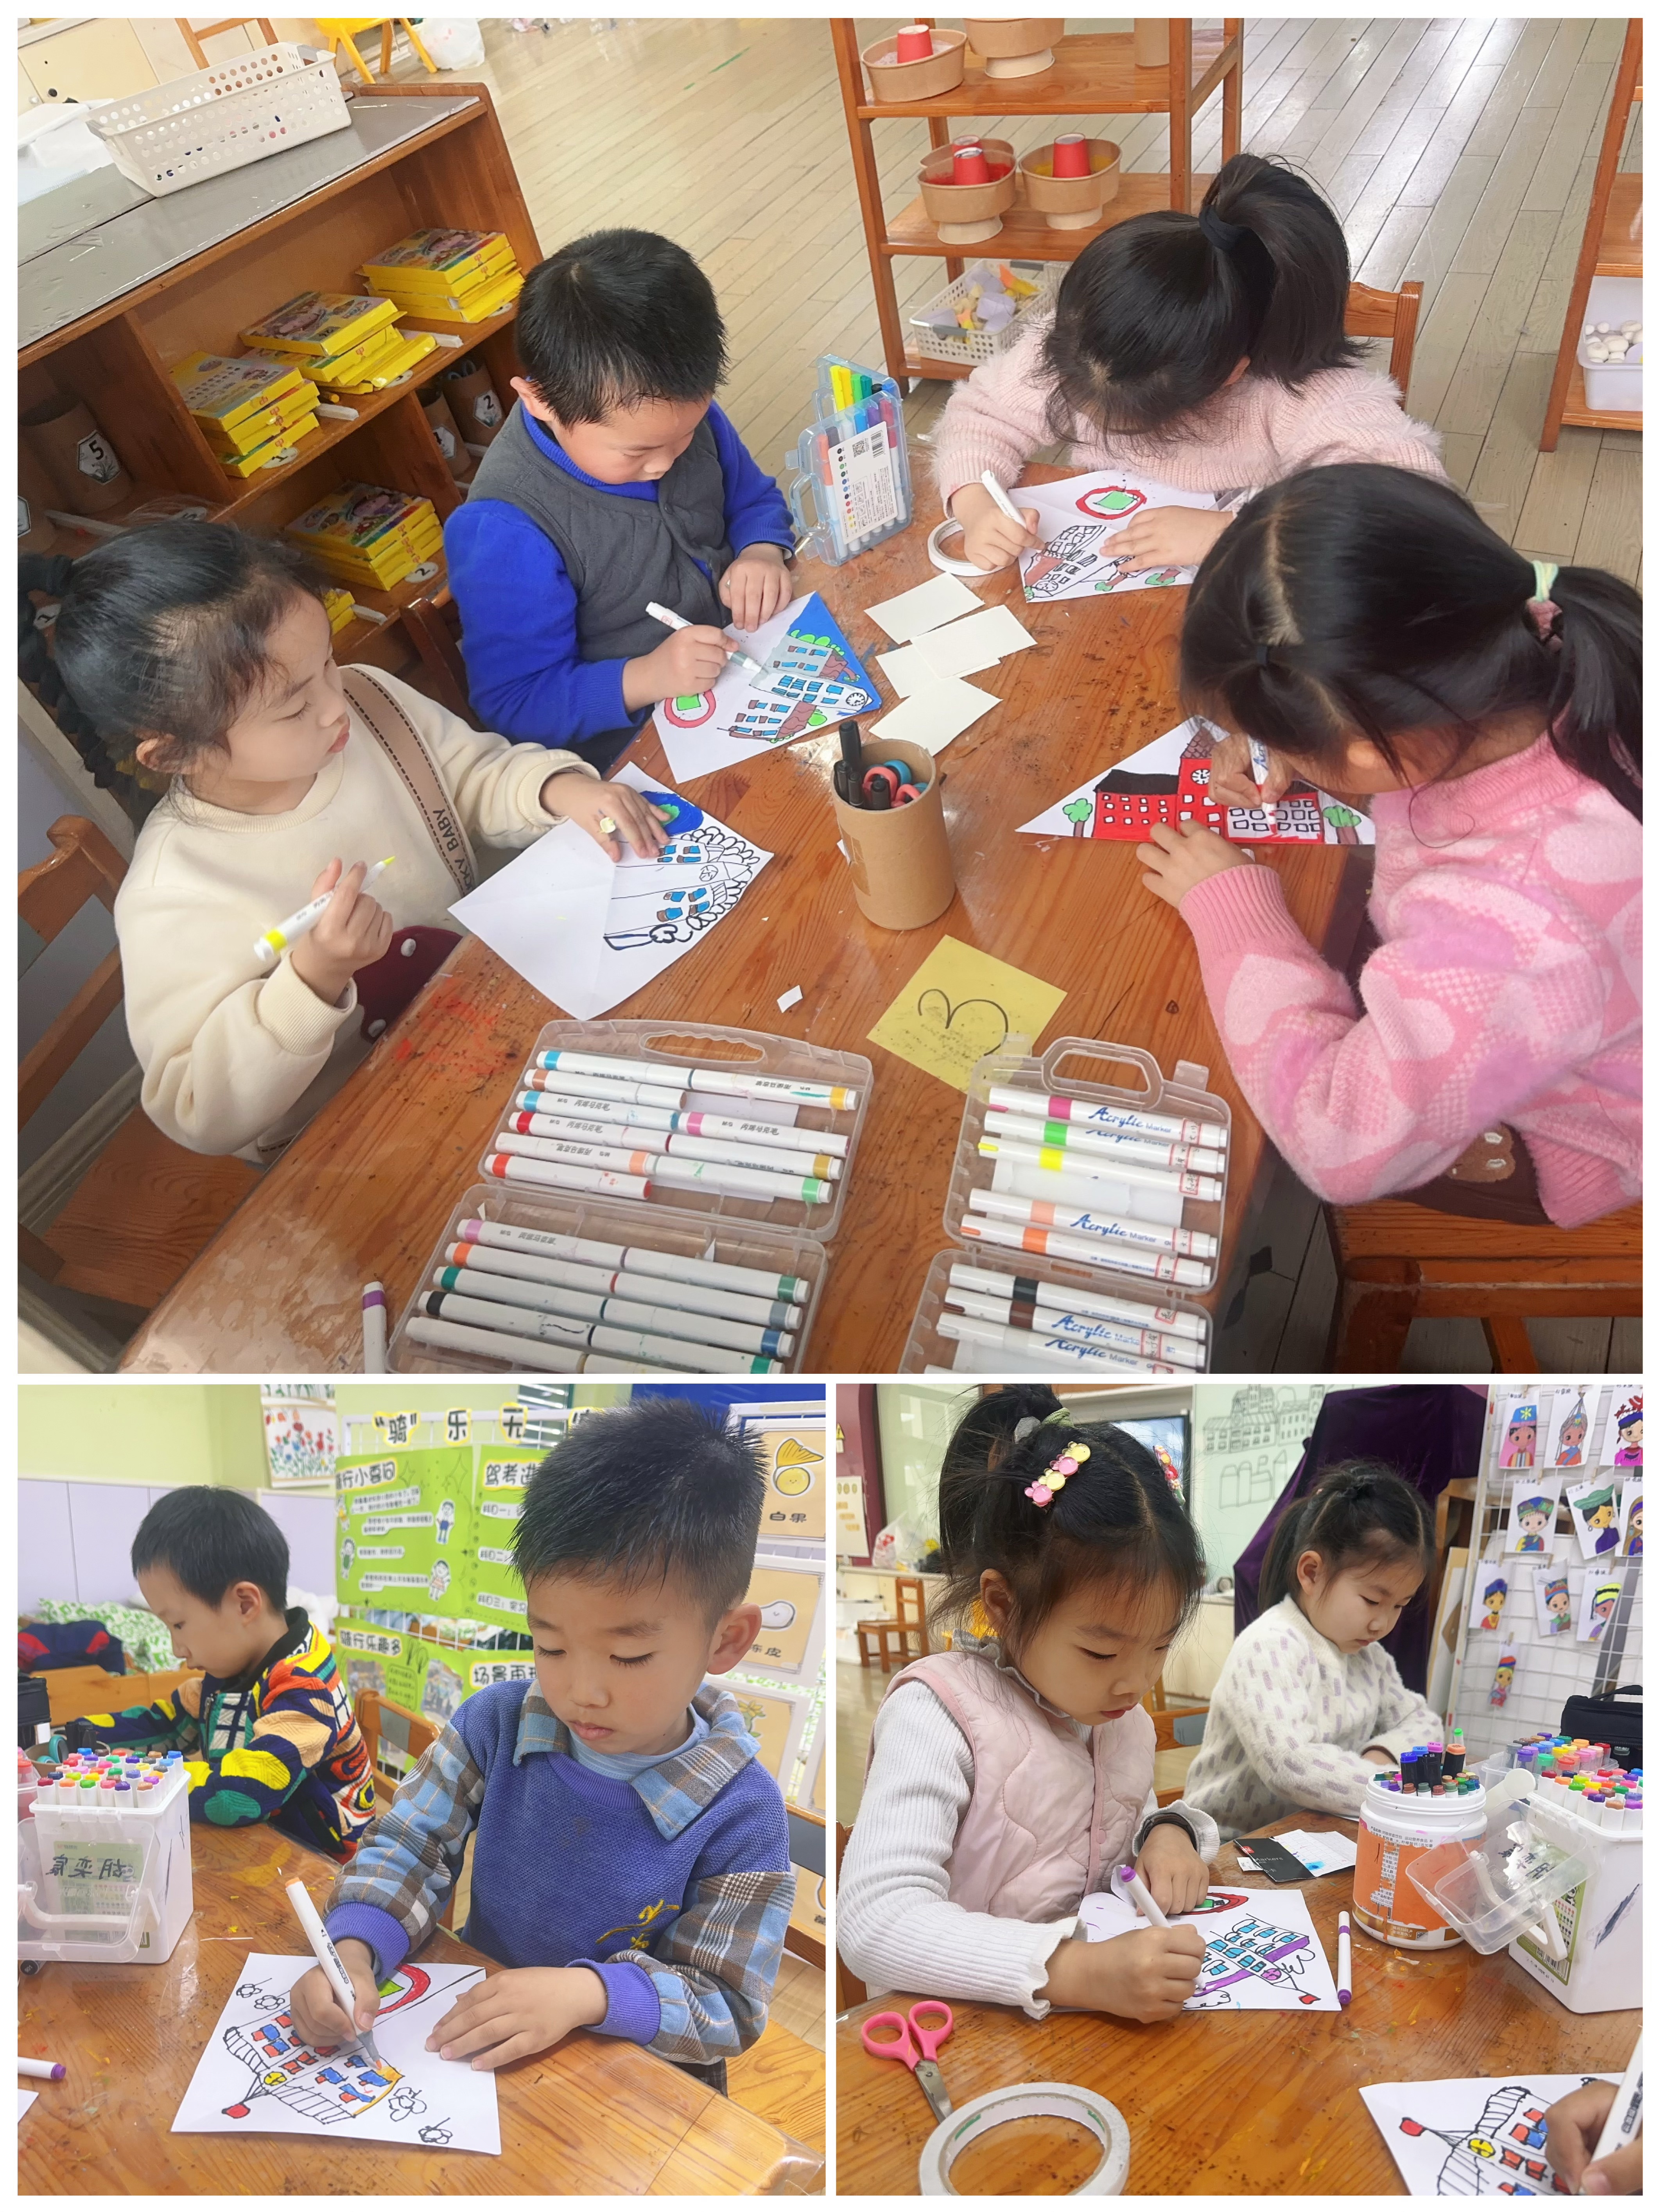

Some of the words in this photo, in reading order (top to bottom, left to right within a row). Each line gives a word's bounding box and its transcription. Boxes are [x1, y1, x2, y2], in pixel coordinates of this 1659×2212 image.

[483, 395, 494, 410] 2
[88, 440, 104, 460] 5
[414, 568, 430, 576] 2
[432, 808, 459, 852] BABY
[741, 1123, 779, 1135] 丙烯马克笔
[1088, 1107, 1143, 1127] Acrylic
[1146, 1123, 1172, 1133] Marker
[1070, 1213, 1128, 1236] Acrylic
[1130, 1232, 1157, 1242] Marker
[1051, 1314, 1112, 1339] Acrylic
[1115, 1333, 1140, 1346] Marke
[1045, 1339, 1107, 1359] Acrylic
[1109, 1353, 1139, 1365] Marker
[375, 1408, 583, 1443] “骑”乐无
[769, 1511, 807, 1523] 白果
